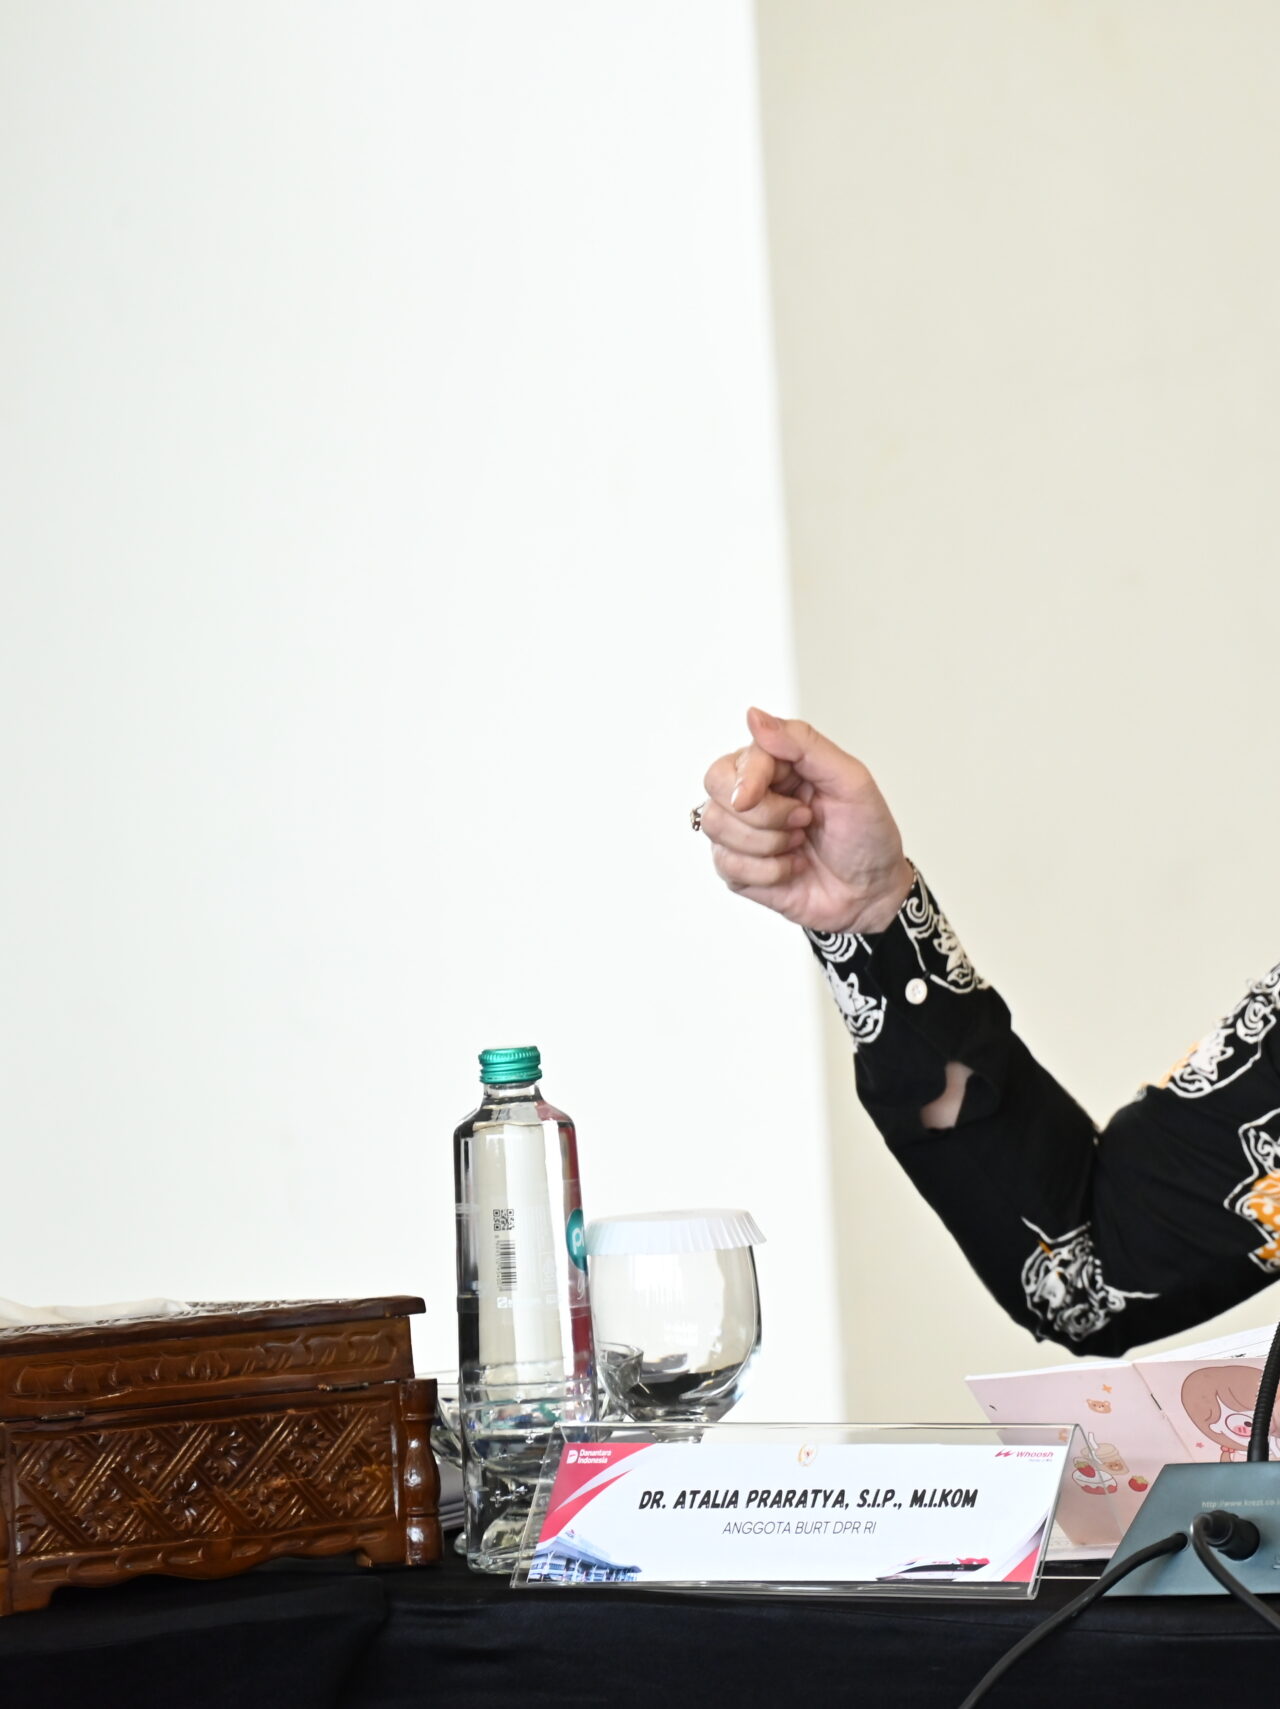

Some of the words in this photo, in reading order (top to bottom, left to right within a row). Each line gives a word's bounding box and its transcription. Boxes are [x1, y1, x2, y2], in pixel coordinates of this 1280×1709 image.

[579, 1448, 612, 1456] Danantara
[1016, 1450, 1054, 1458] Whoosh
[577, 1456, 608, 1464] Indonesia
[638, 1489, 667, 1510] DR.
[672, 1489, 740, 1510] ATALIA
[745, 1488, 850, 1511] PRARATYA,
[856, 1488, 903, 1511] S.I.P.,
[908, 1488, 979, 1509] M.I.KOM
[721, 1520, 791, 1535] ANGGOTA
[794, 1520, 831, 1535] BURT
[832, 1520, 862, 1535] DPR
[863, 1520, 877, 1535] RI
